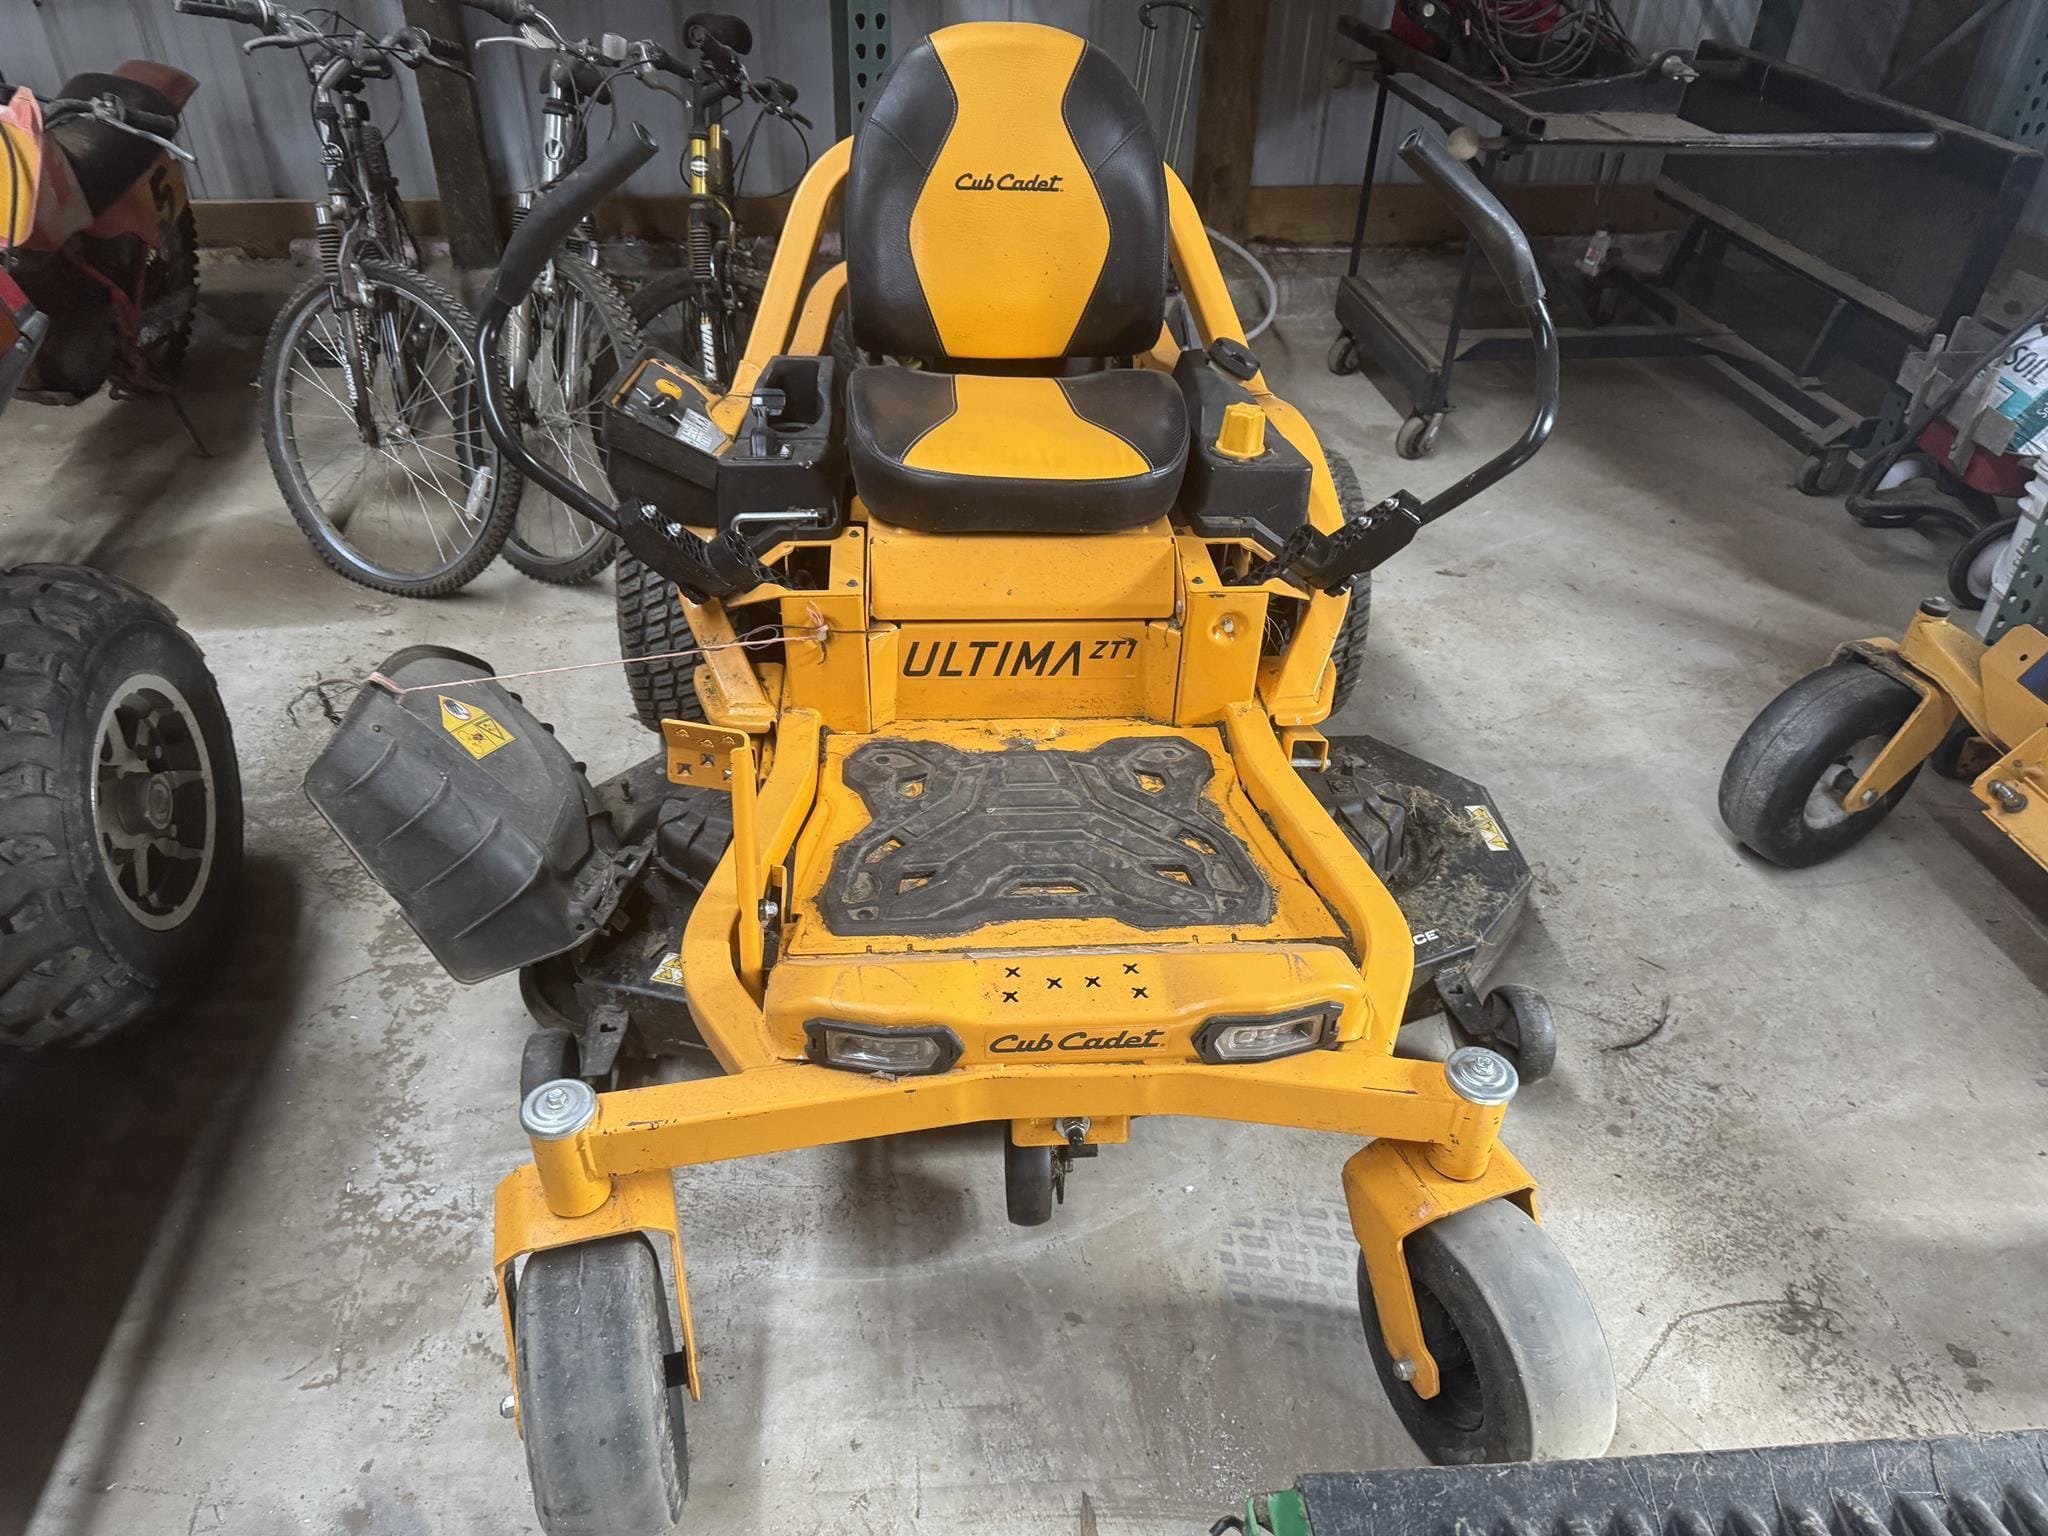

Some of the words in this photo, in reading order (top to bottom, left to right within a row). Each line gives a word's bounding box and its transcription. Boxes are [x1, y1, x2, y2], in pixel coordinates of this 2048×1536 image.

[955, 173, 994, 190] Cub
[997, 173, 1063, 192] Cadet
[700, 323, 717, 381] VORTEX
[2004, 345, 2048, 386] SOIL
[903, 641, 1081, 677] ULTIMA
[1412, 929, 1440, 945] CE
[990, 1033, 1054, 1053] Cub
[1057, 1029, 1166, 1051] Cadet
